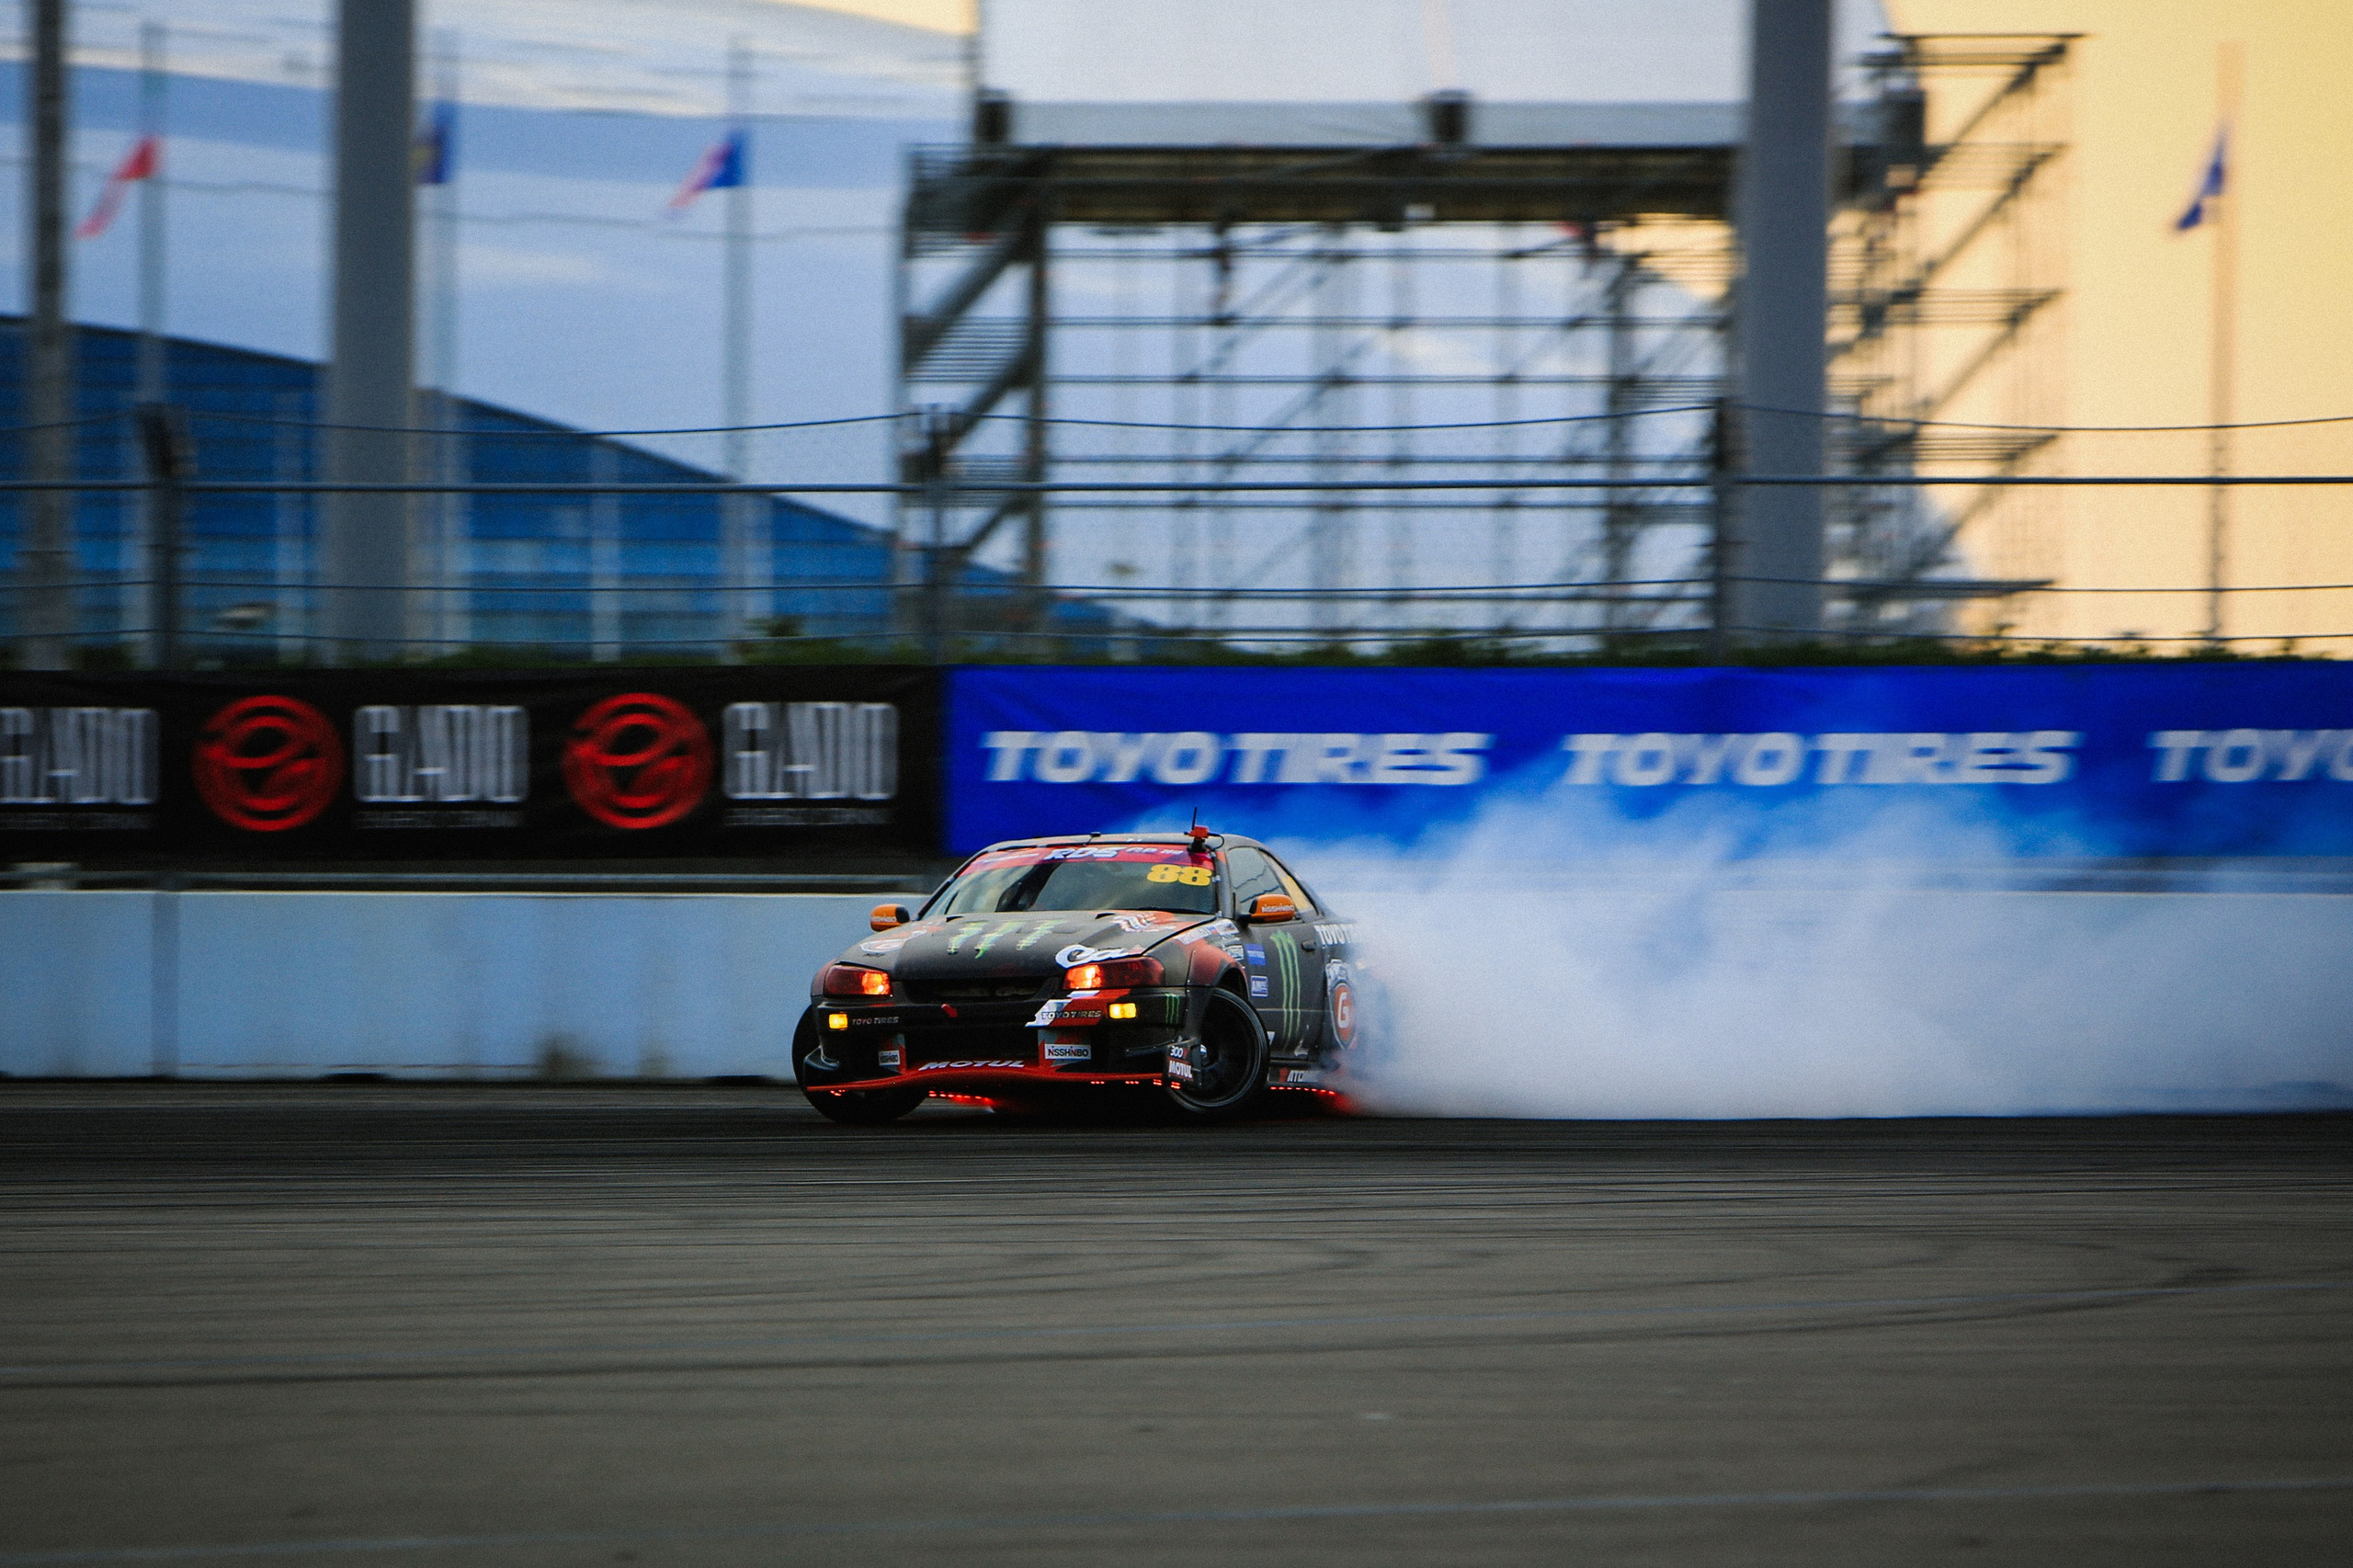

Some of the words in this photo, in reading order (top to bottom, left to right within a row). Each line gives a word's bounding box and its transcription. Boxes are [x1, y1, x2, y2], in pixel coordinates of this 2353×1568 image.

[980, 731, 1222, 784] TOYO
[1224, 732, 1494, 785] TIRES
[1563, 732, 1804, 786] TOYO
[1812, 731, 2083, 784] TIRES
[1044, 846, 1127, 860] RDS
[1147, 864, 1213, 887] 88
[851, 1017, 873, 1026] TOYO
[873, 1016, 900, 1025] TIRES
[1040, 1010, 1070, 1019] TOYO
[1070, 1010, 1103, 1018] TIRES
[919, 1060, 1026, 1072] MOTUL
[1168, 1060, 1193, 1079] MOTUL
